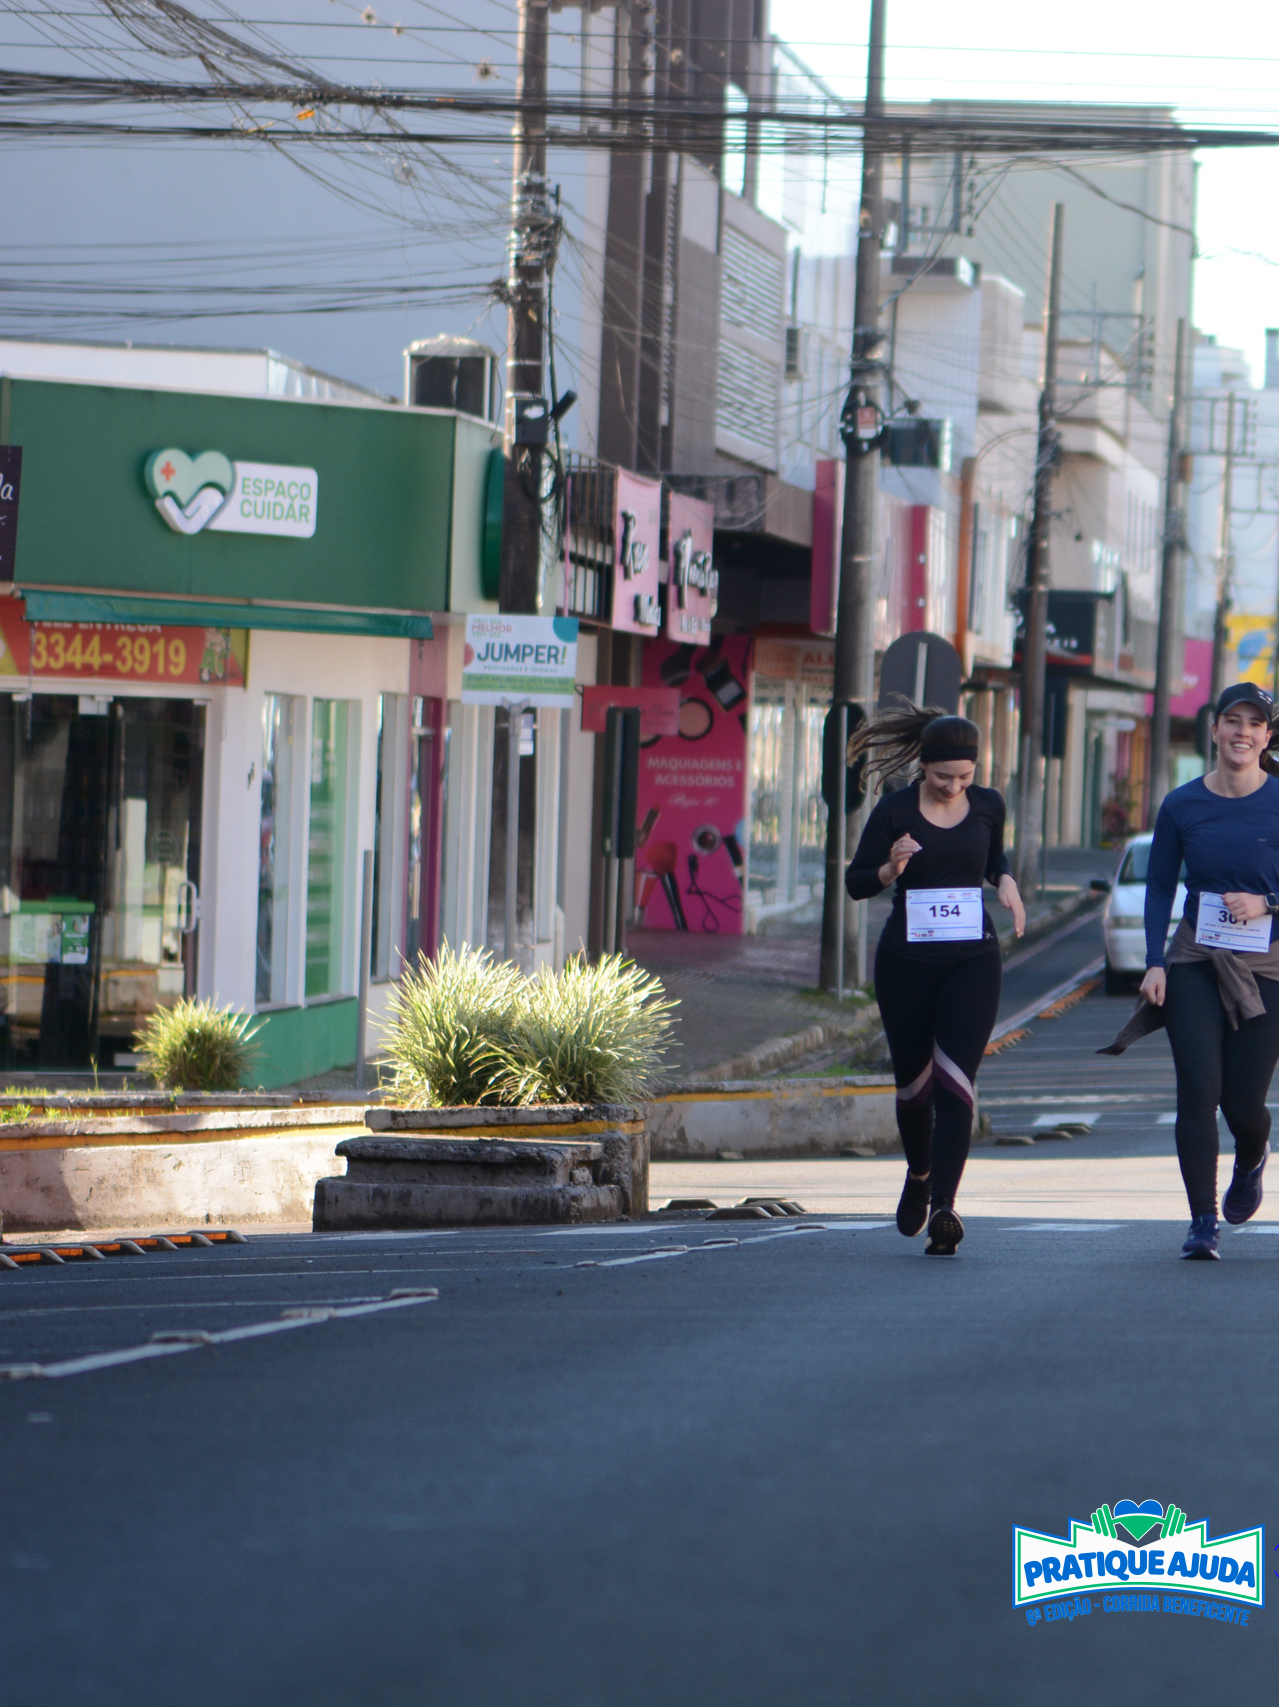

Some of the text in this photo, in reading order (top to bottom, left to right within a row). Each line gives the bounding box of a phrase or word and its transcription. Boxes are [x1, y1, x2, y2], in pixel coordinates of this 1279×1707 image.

[241, 477, 311, 502] ESPAÇO
[472, 624, 513, 633] MELHOR
[32, 631, 187, 676] 3344-3919
[477, 642, 568, 665] JUMPER!
[648, 757, 734, 772] MAQUIAGENS
[929, 904, 961, 918] 154
